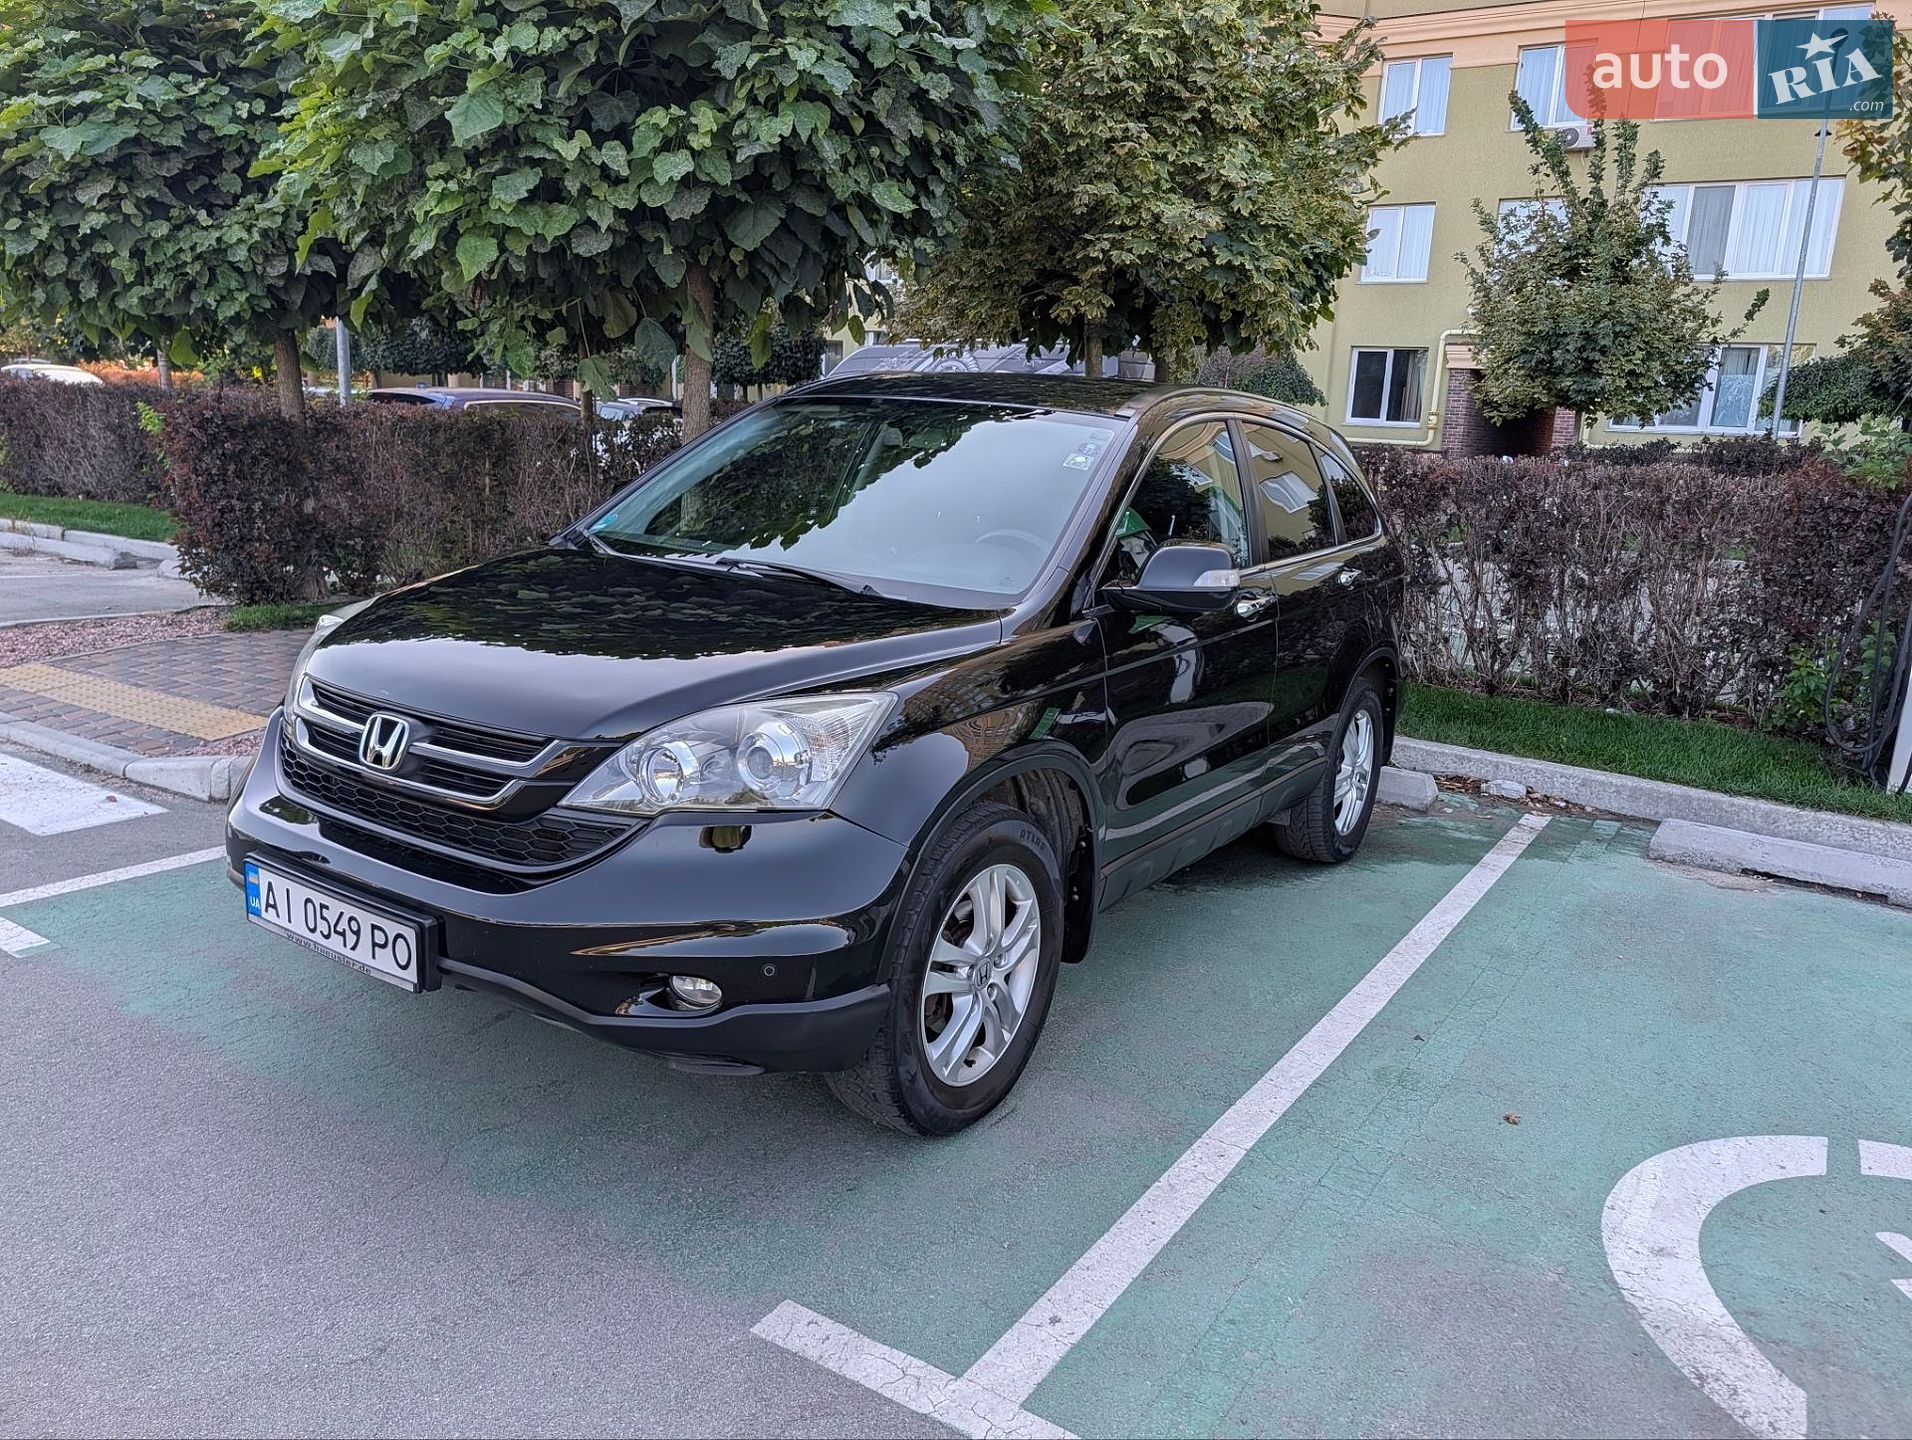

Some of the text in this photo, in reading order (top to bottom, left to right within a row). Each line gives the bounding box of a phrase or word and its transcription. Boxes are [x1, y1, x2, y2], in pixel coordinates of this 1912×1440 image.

[250, 896, 261, 908] UA
[264, 881, 412, 971] AI 0549 PO
